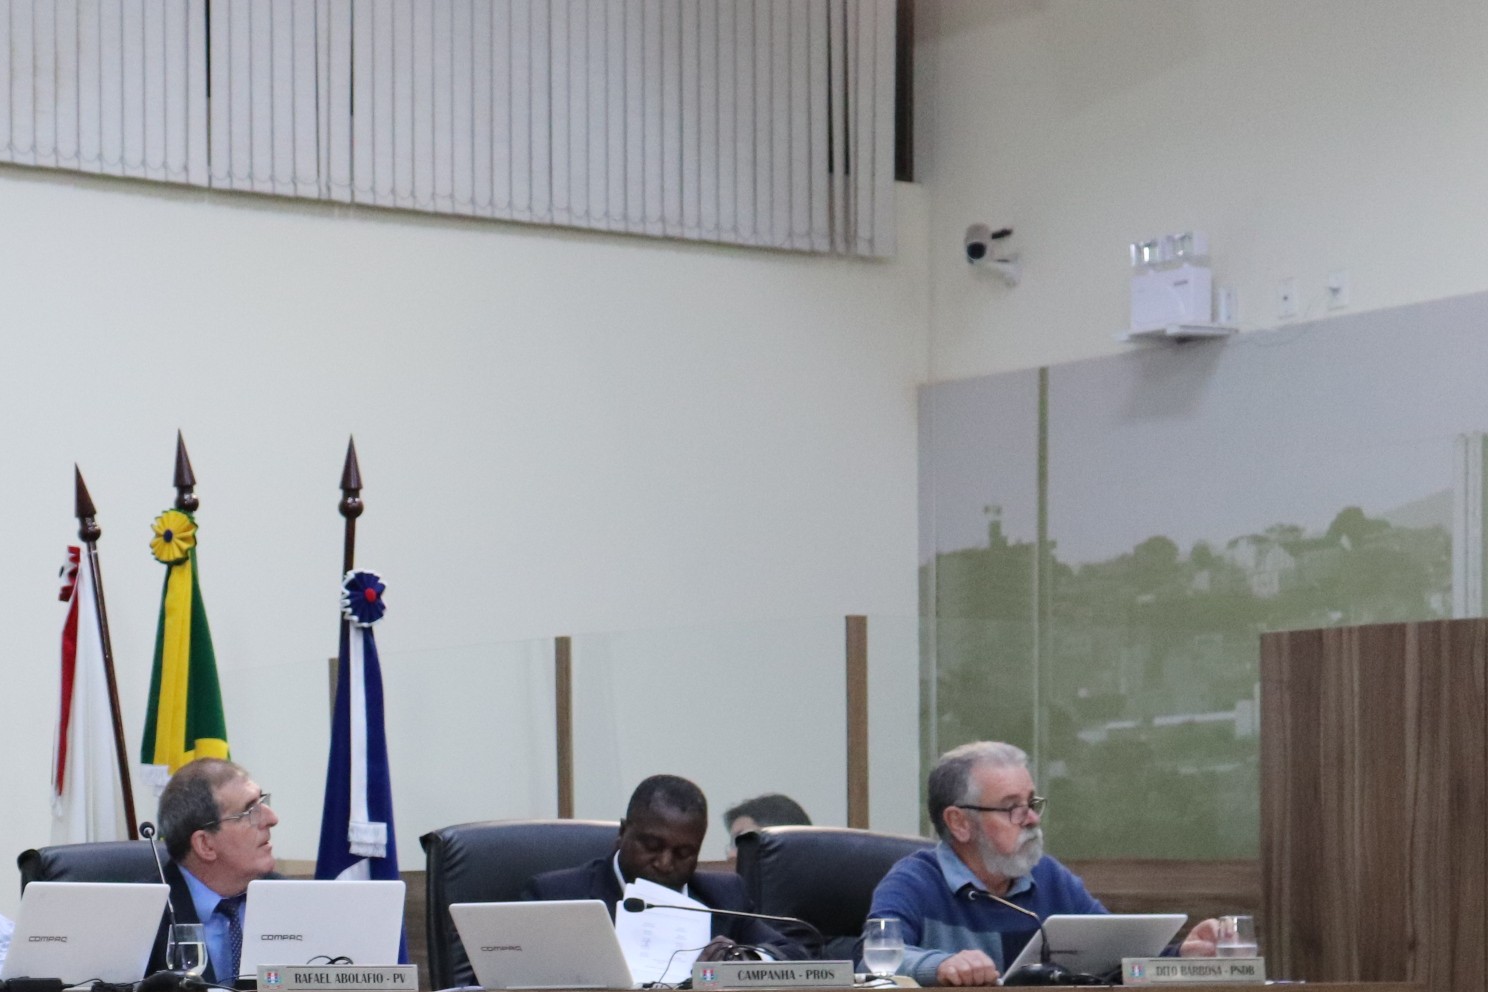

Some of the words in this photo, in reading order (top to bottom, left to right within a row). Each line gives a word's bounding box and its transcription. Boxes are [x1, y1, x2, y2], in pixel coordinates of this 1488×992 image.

[294, 973, 332, 984] RAFAEL
[335, 973, 383, 984] ABOLAFIO
[393, 973, 406, 983] PV
[737, 970, 796, 981] CAMPANHA
[805, 969, 835, 980] PROS
